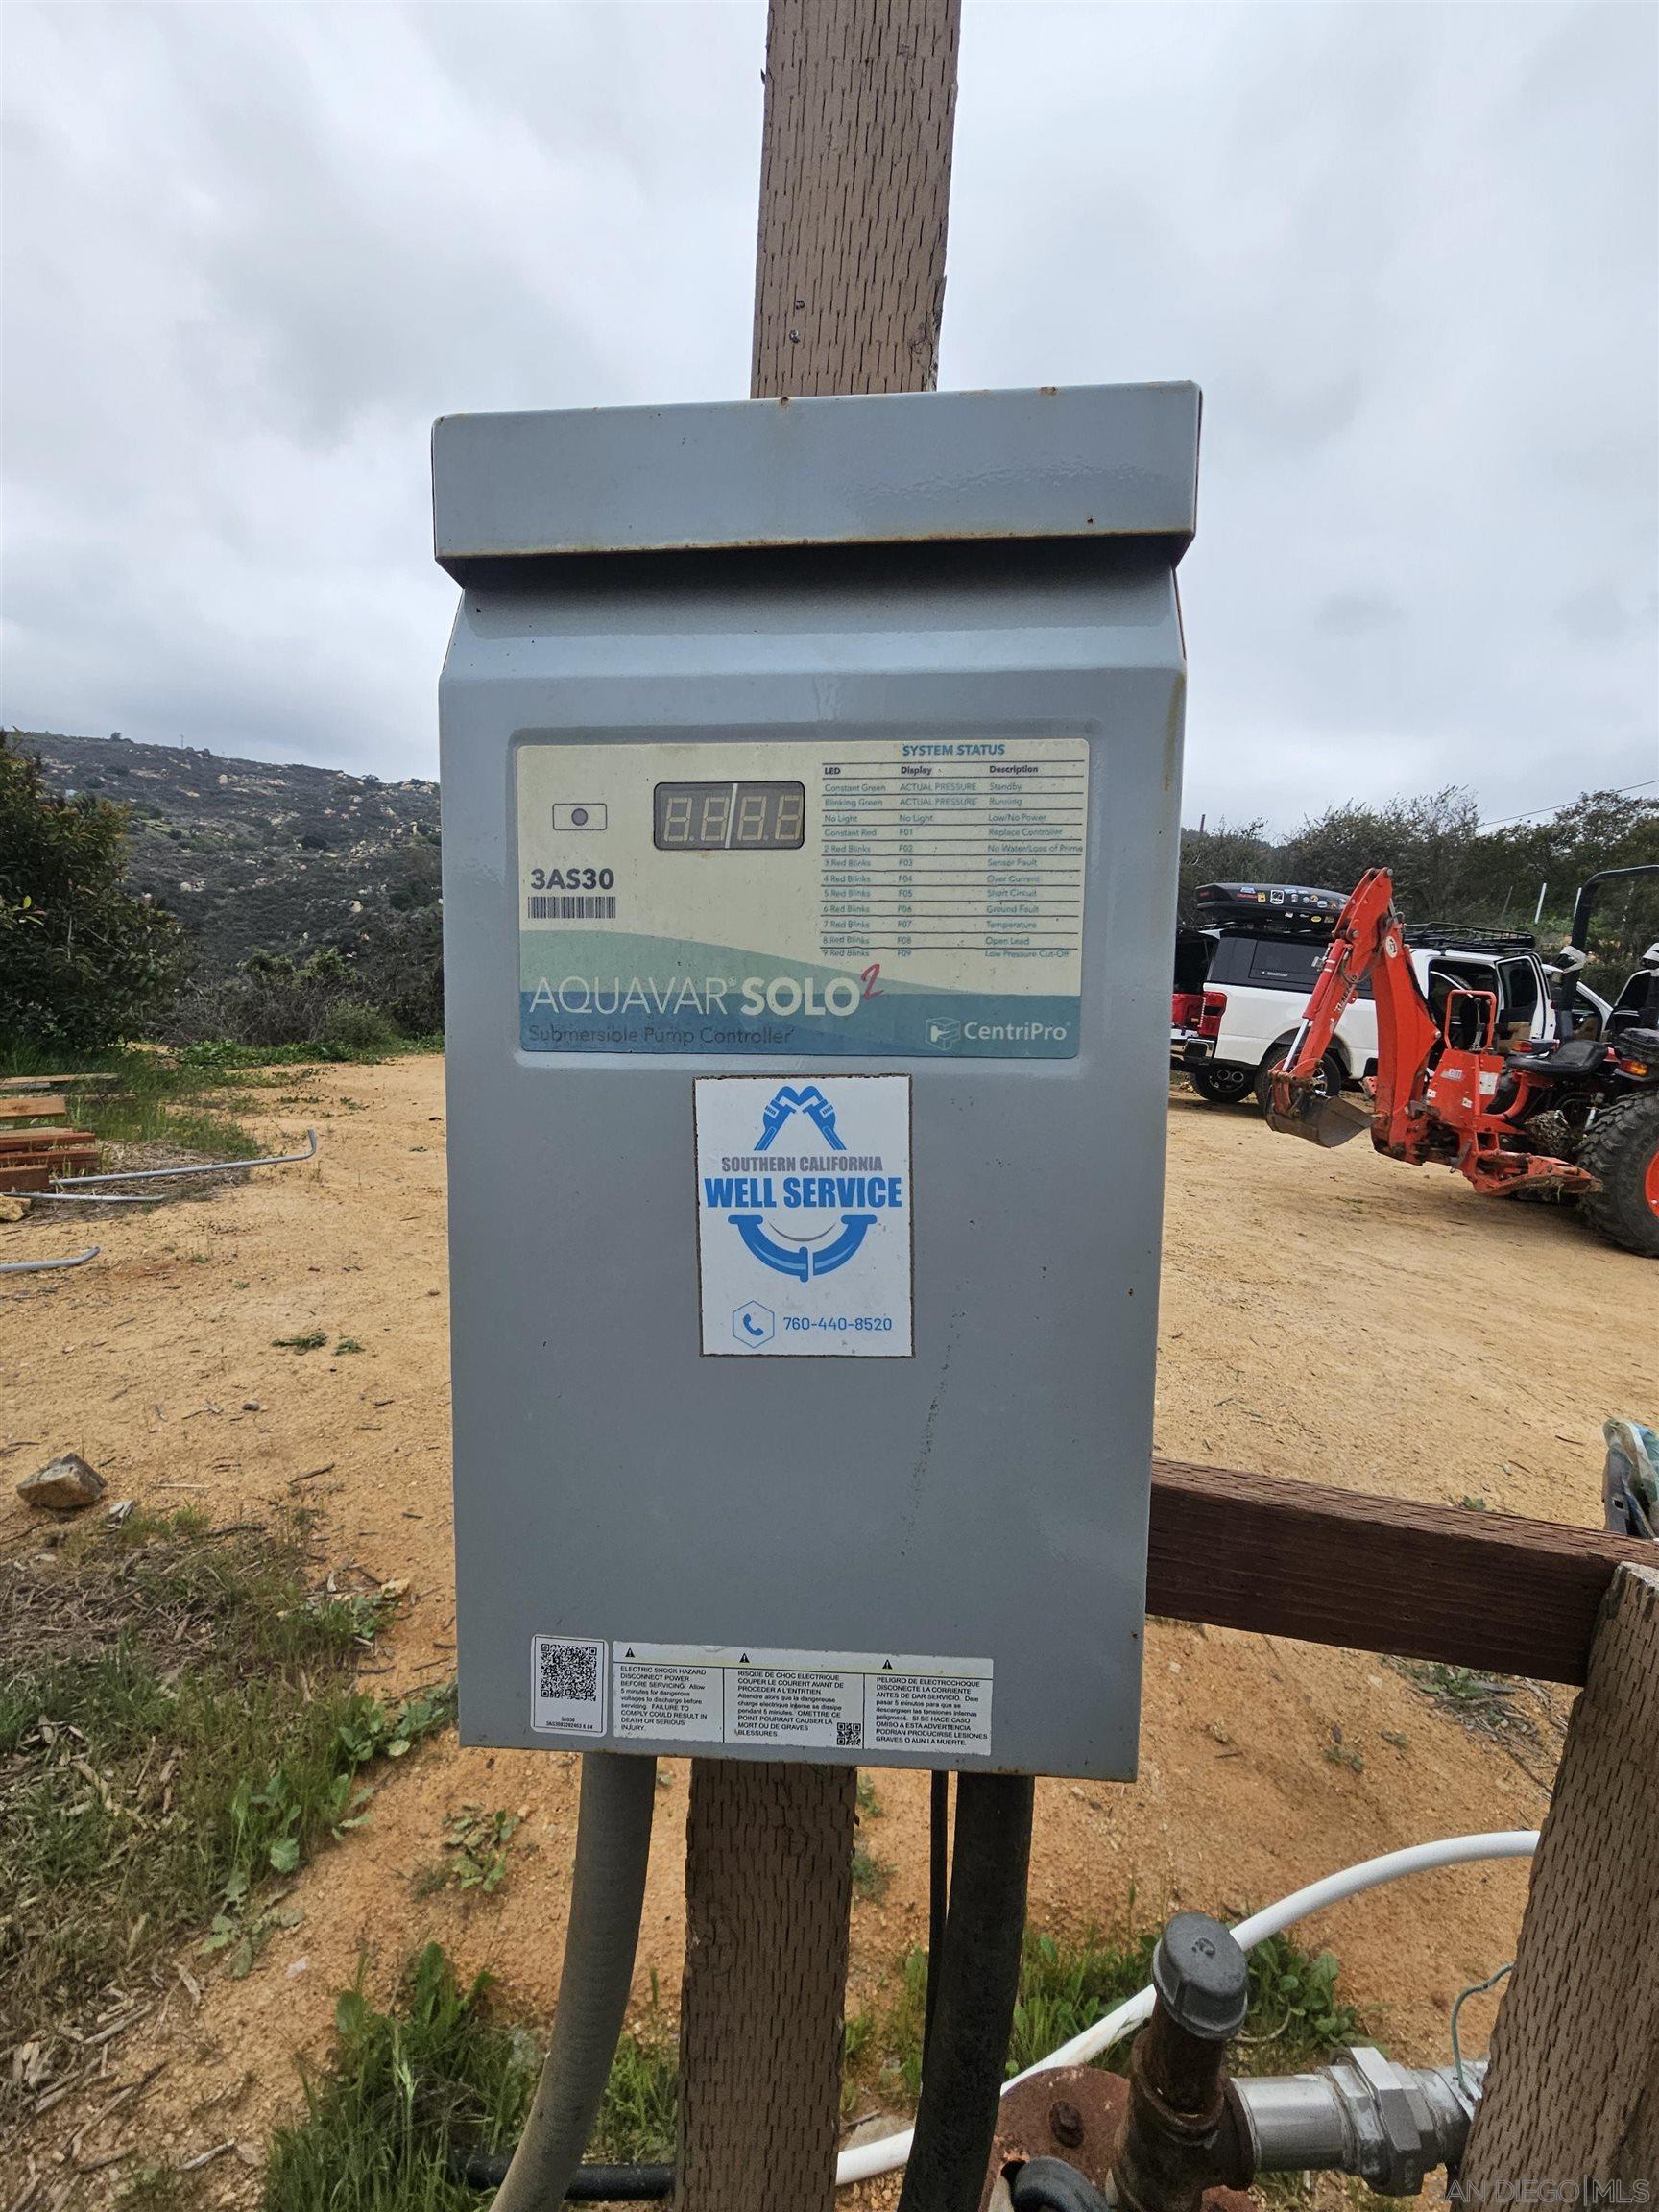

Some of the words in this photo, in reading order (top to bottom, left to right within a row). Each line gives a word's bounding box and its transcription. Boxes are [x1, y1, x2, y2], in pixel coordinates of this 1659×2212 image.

[902, 745, 953, 757] SYSTEM
[956, 743, 1006, 755] STATUS
[901, 766, 932, 776] Display
[990, 765, 1038, 774] Description
[825, 783, 859, 792] Constant
[862, 783, 885, 792] Green
[935, 782, 976, 791] PRESSURE
[990, 782, 1022, 791] Standby
[825, 799, 856, 807] Blinking
[859, 798, 883, 806] Green
[900, 798, 932, 806] ACTUAL
[989, 798, 1022, 806] Running
[838, 815, 857, 824] Light
[913, 814, 933, 824] Light
[825, 829, 859, 837] Constant
[989, 828, 1020, 836] Replace
[1022, 828, 1062, 836] Controller
[531, 868, 614, 890] 3AS30
[986, 921, 1037, 929] Temperature
[986, 936, 1008, 945] Open
[530, 1024, 638, 1043] Submersible
[644, 1026, 694, 1046] Pump
[700, 1026, 791, 1045] Controller
[964, 1022, 1068, 1041] CentriPro
[722, 1156, 796, 1172] SOUTHERN
[800, 1156, 883, 1172] CALIFORNIA
[705, 1177, 777, 1208] WELL
[783, 1177, 902, 1208] SERVICE
[783, 1316, 892, 1332] 760-440-8520
